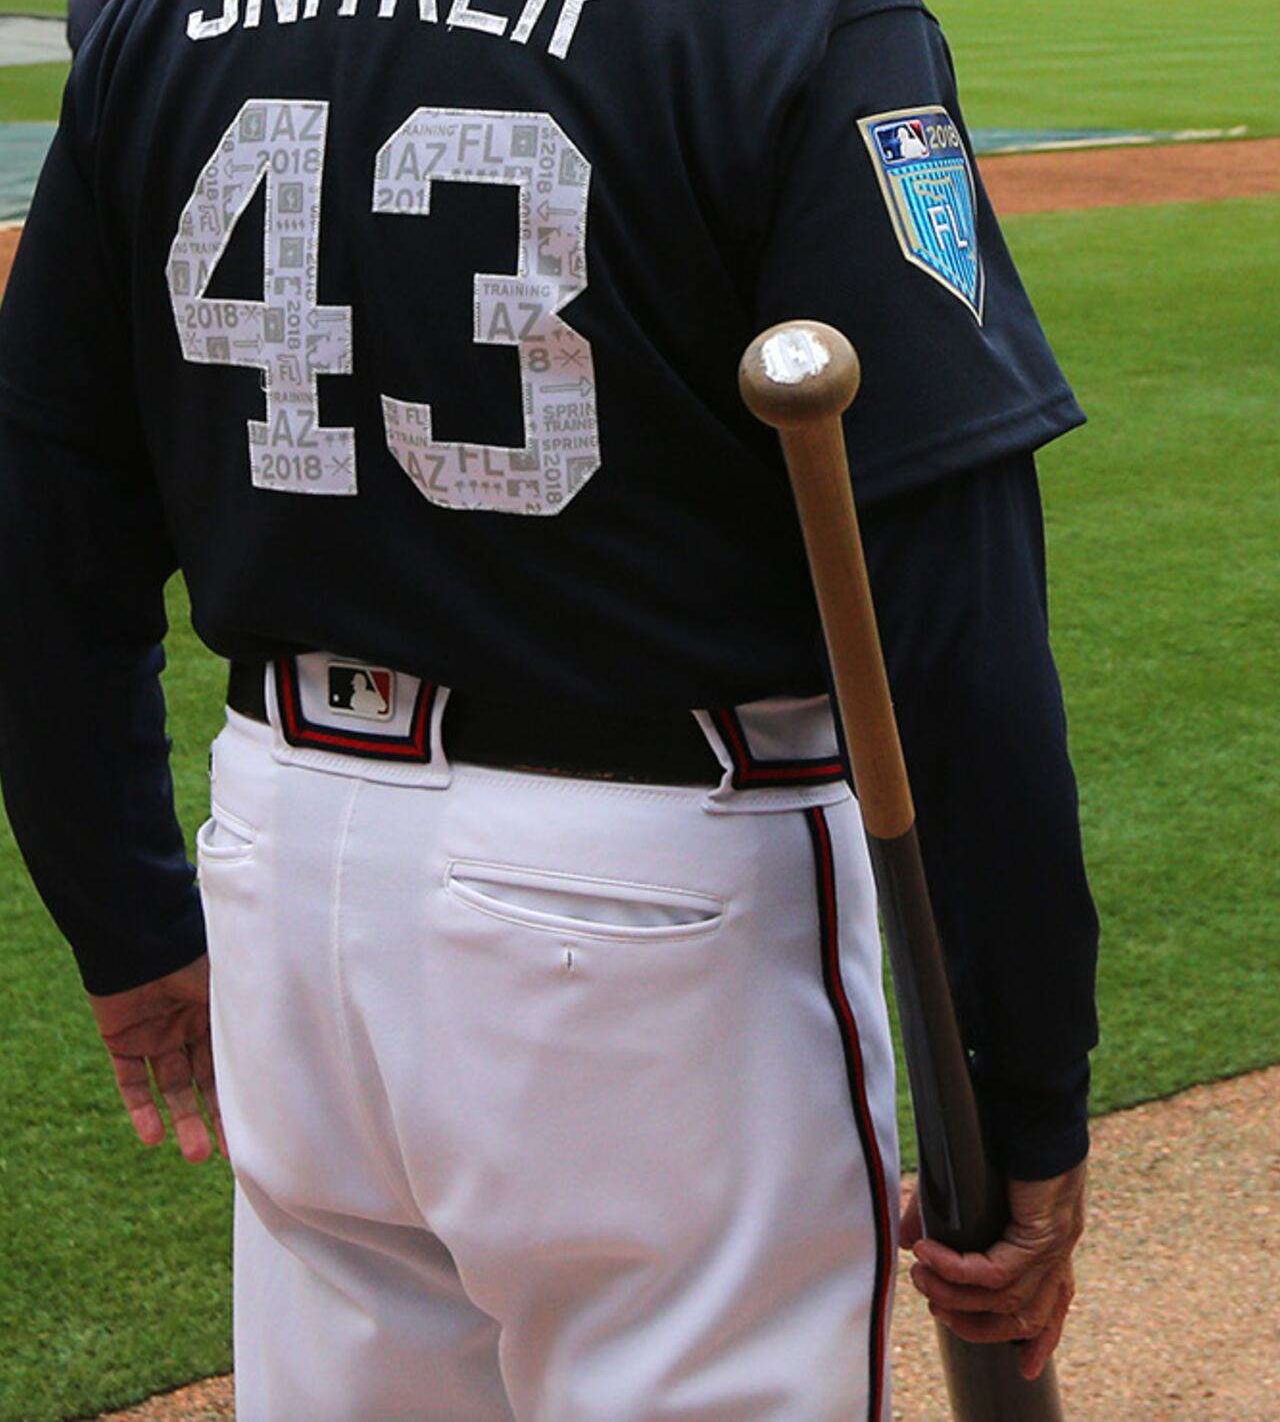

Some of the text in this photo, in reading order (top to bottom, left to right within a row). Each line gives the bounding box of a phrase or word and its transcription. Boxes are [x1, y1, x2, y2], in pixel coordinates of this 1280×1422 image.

[457, 123, 504, 163] FL
[926, 123, 961, 150] 2018
[927, 204, 968, 250] FL
[165, 98, 602, 516] 43
[483, 283, 552, 298] TRAINING
[184, 304, 239, 329] 2018
[486, 301, 545, 343] AZ
[271, 409, 318, 449] AZ
[261, 453, 324, 481] 2018
